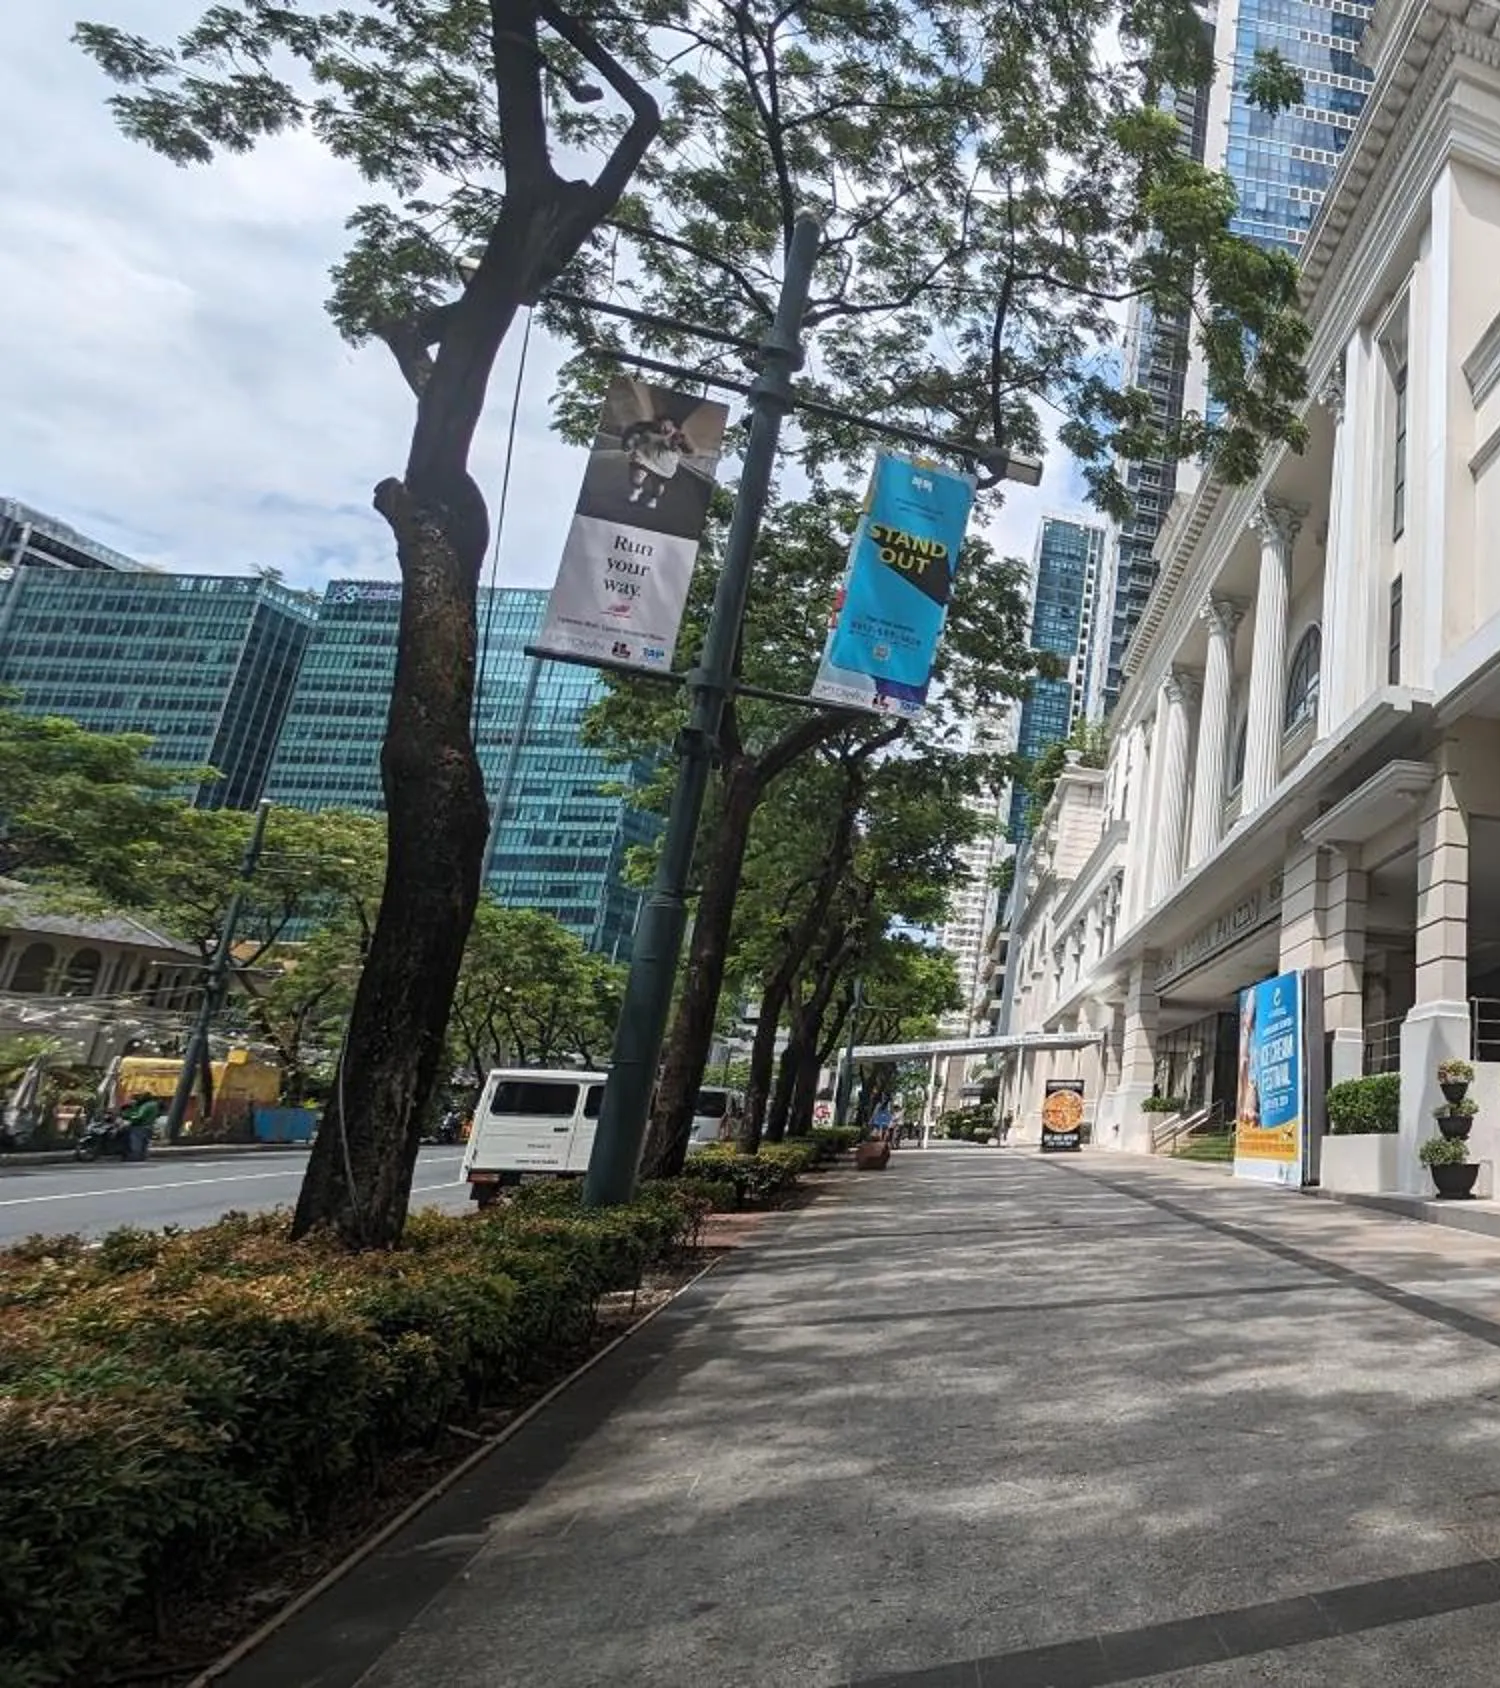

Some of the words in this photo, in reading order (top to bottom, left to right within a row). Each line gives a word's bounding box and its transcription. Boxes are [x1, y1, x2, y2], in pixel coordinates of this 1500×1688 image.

[614, 535, 653, 556] Run
[869, 525, 947, 558] STAND
[606, 557, 651, 577] your
[880, 547, 931, 575] OUT
[603, 578, 641, 601] way.
